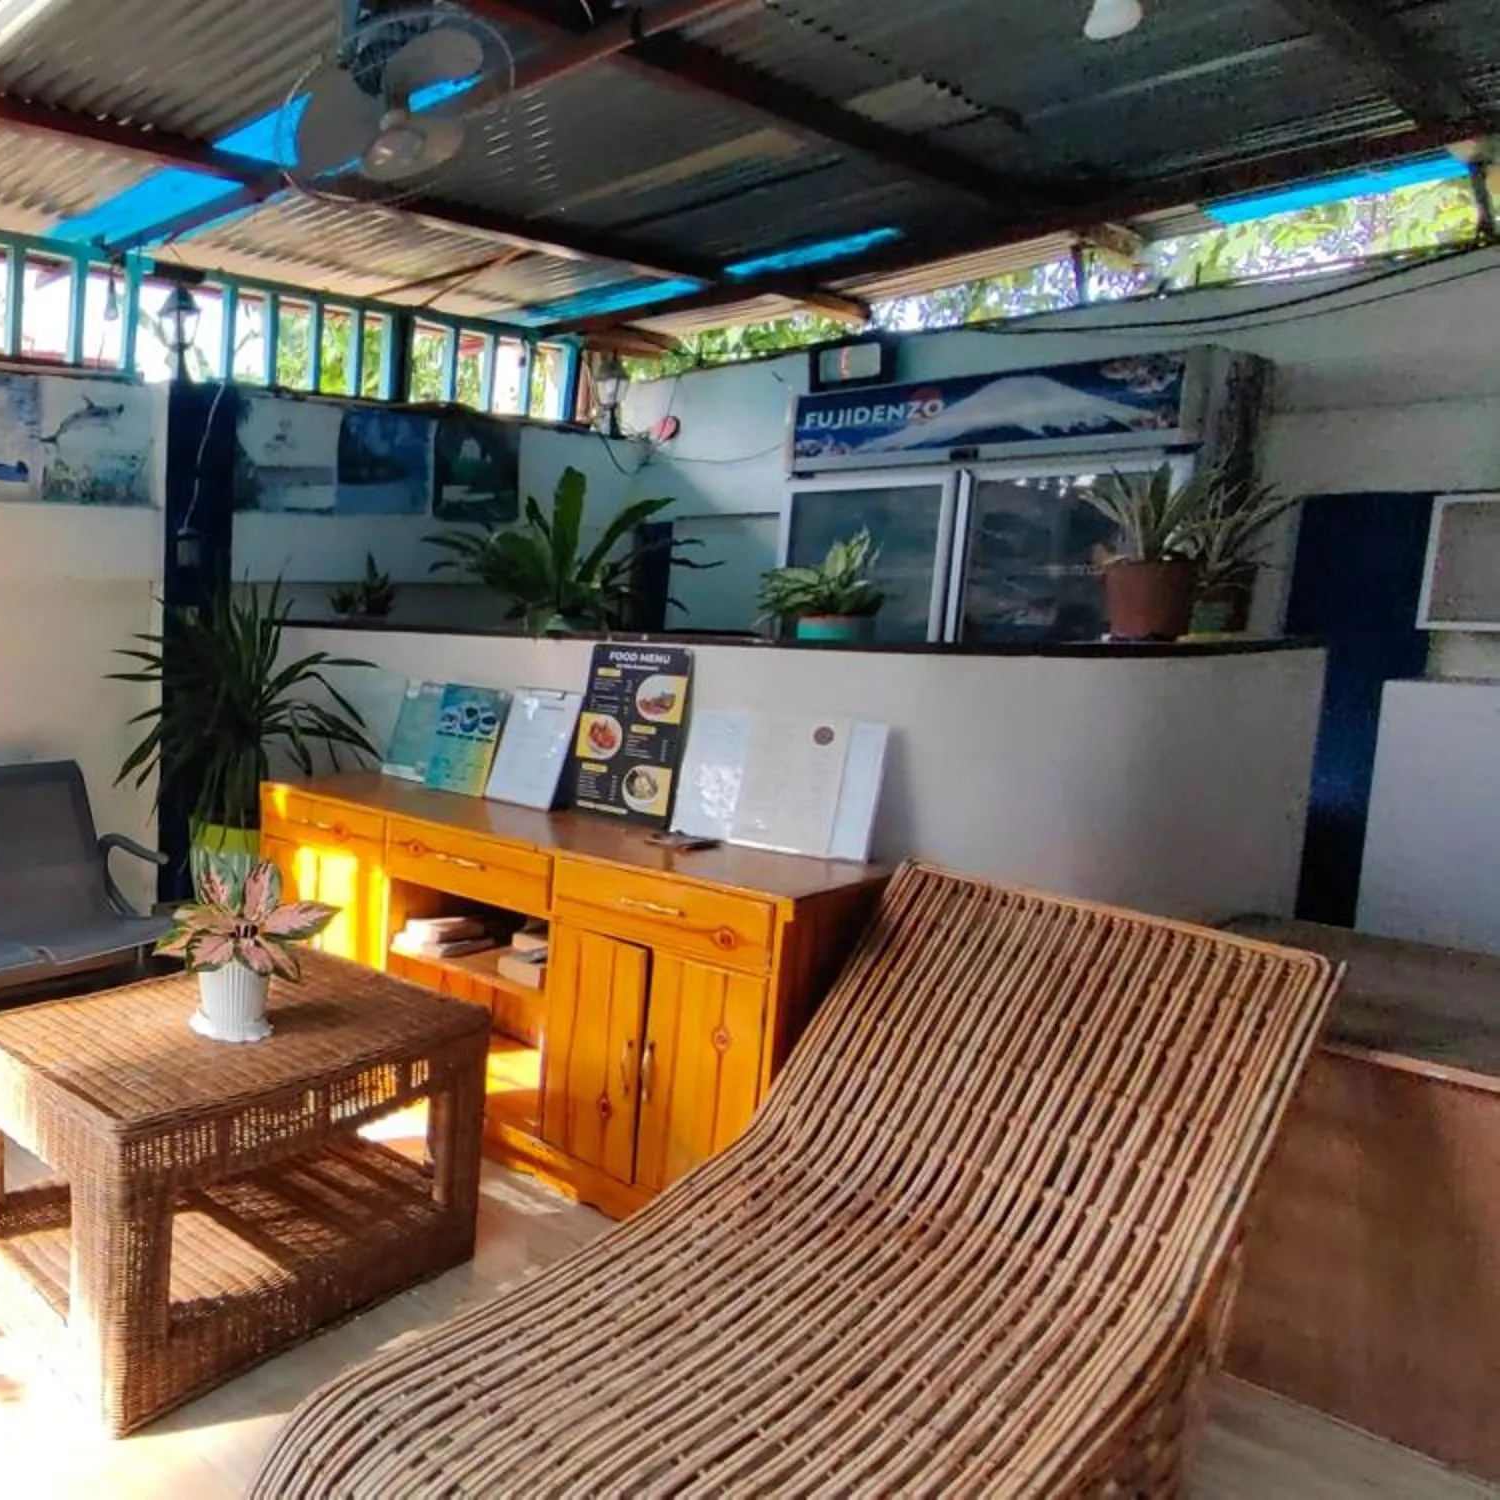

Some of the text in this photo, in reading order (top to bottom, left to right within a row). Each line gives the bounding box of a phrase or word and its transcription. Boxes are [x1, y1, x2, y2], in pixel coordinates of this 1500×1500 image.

[803, 400, 945, 430] FUJIDENZO
[609, 651, 671, 665] FOOD MENU
